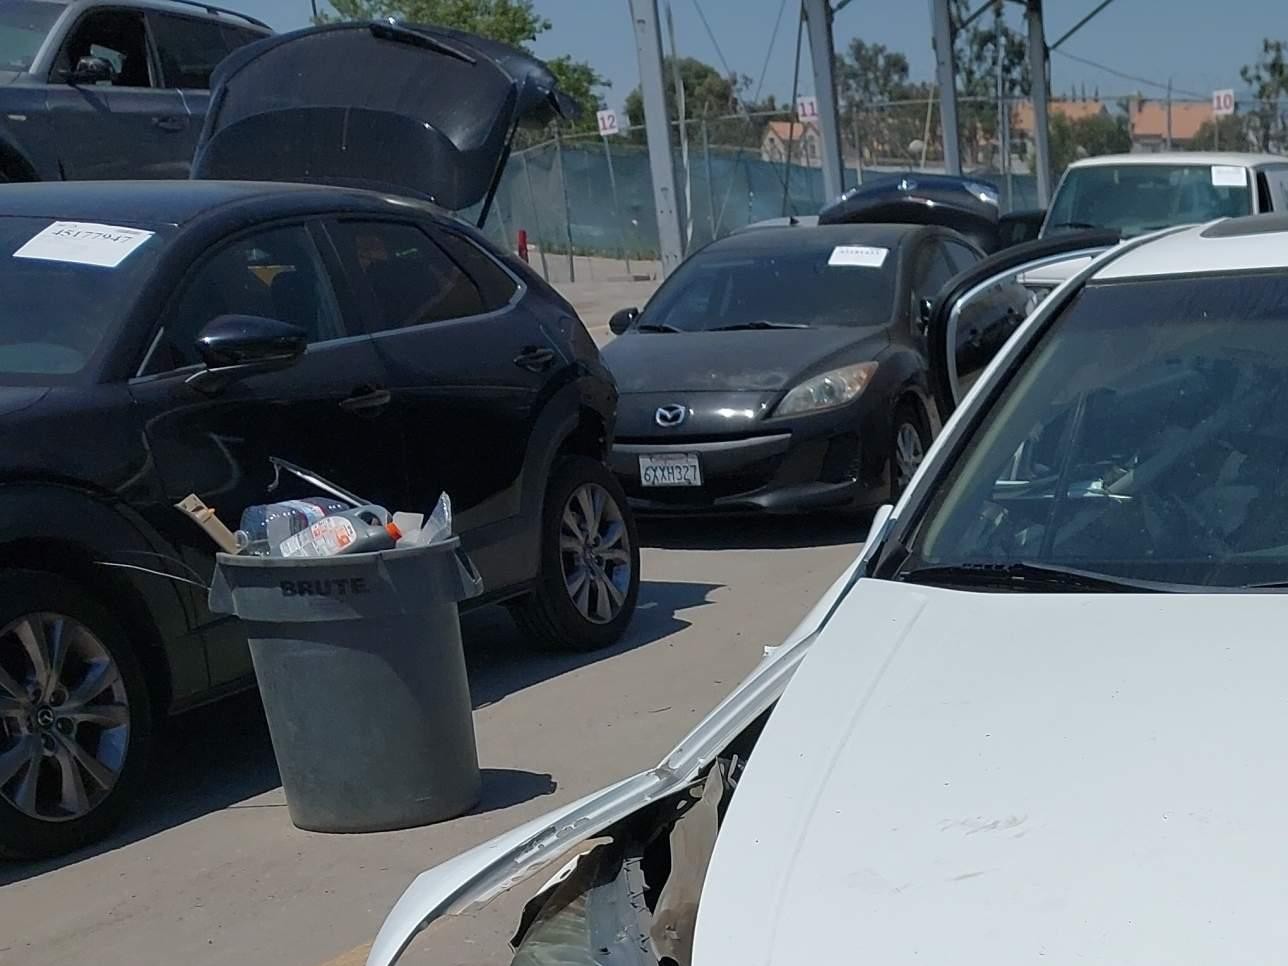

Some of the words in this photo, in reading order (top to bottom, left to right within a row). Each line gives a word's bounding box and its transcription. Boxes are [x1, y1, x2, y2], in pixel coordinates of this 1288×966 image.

[801, 101, 818, 117] 11
[1216, 94, 1233, 110] 10
[600, 114, 616, 130] 12
[643, 464, 698, 482] 6XXH327
[280, 577, 369, 597] BRUTE
